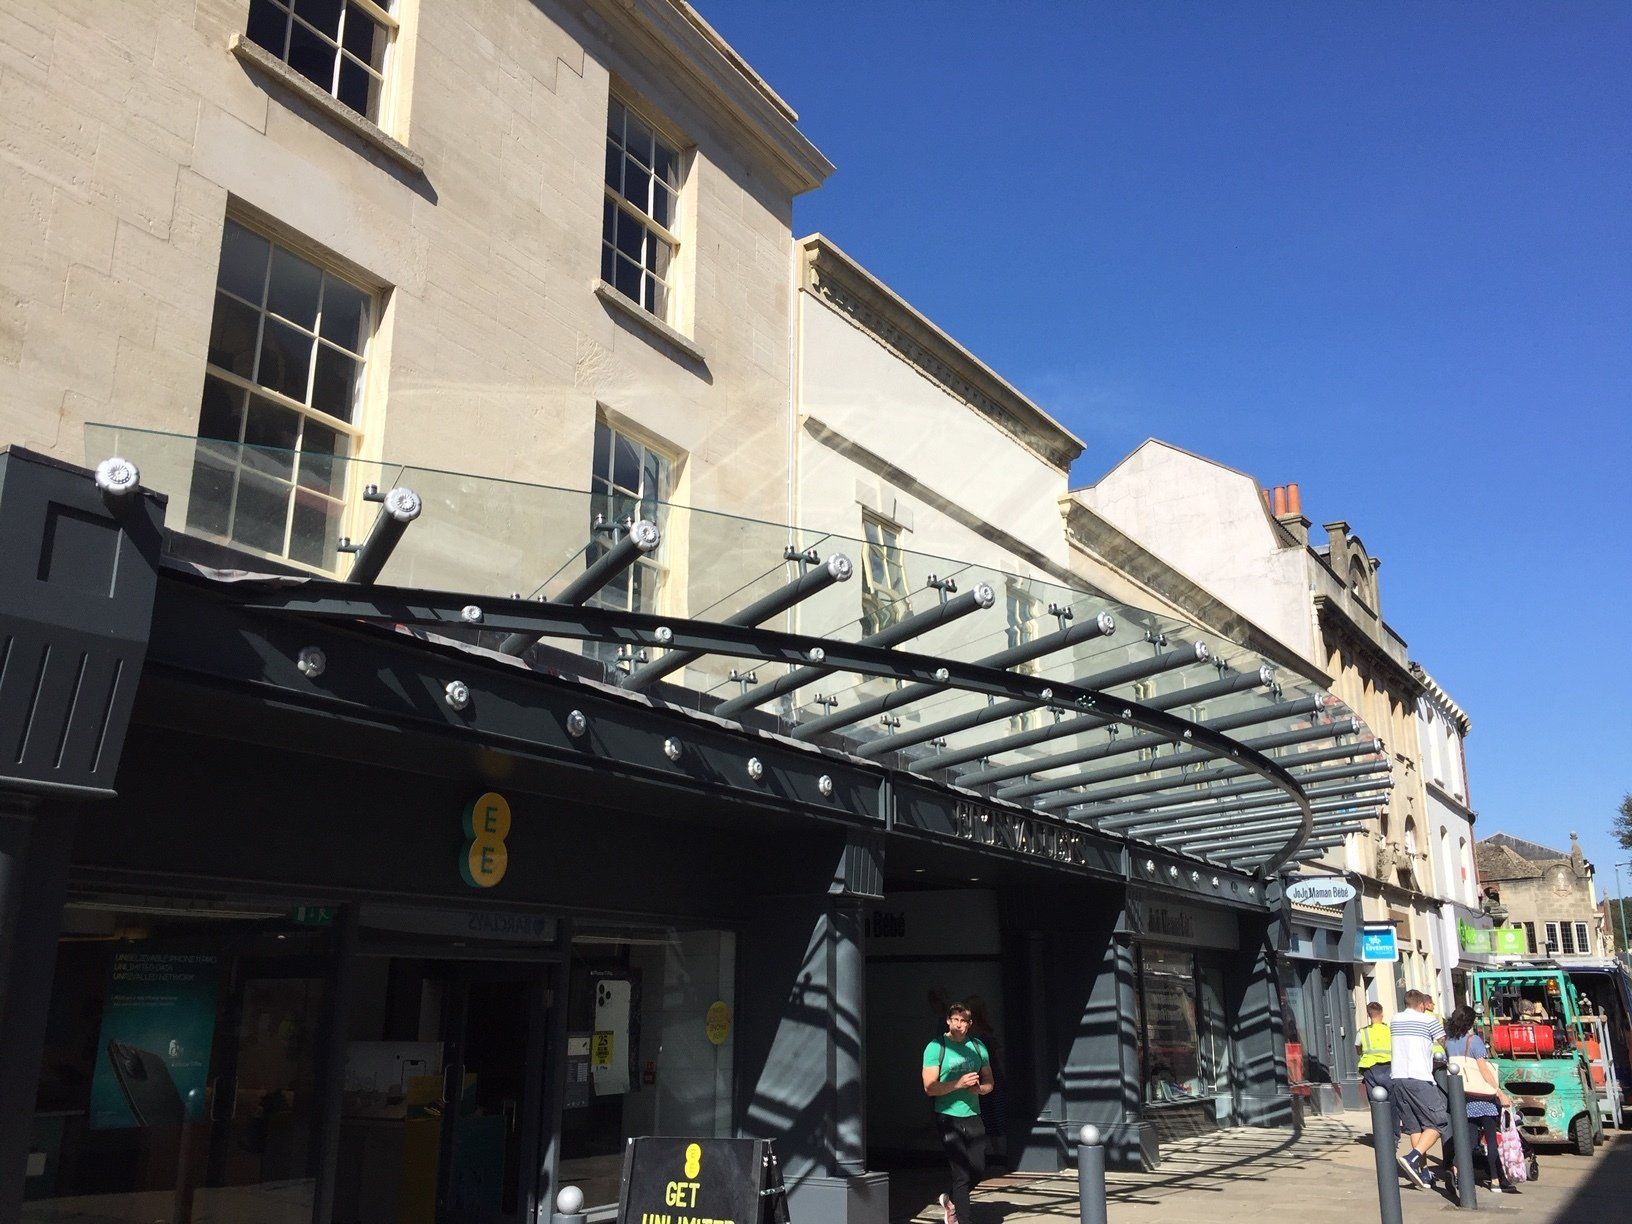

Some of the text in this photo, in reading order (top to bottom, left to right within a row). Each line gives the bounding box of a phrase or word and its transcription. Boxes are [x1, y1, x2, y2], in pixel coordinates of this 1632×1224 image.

[1293, 886, 1349, 899] JoJo Maman Bébé
[665, 1180, 701, 1209] GET
